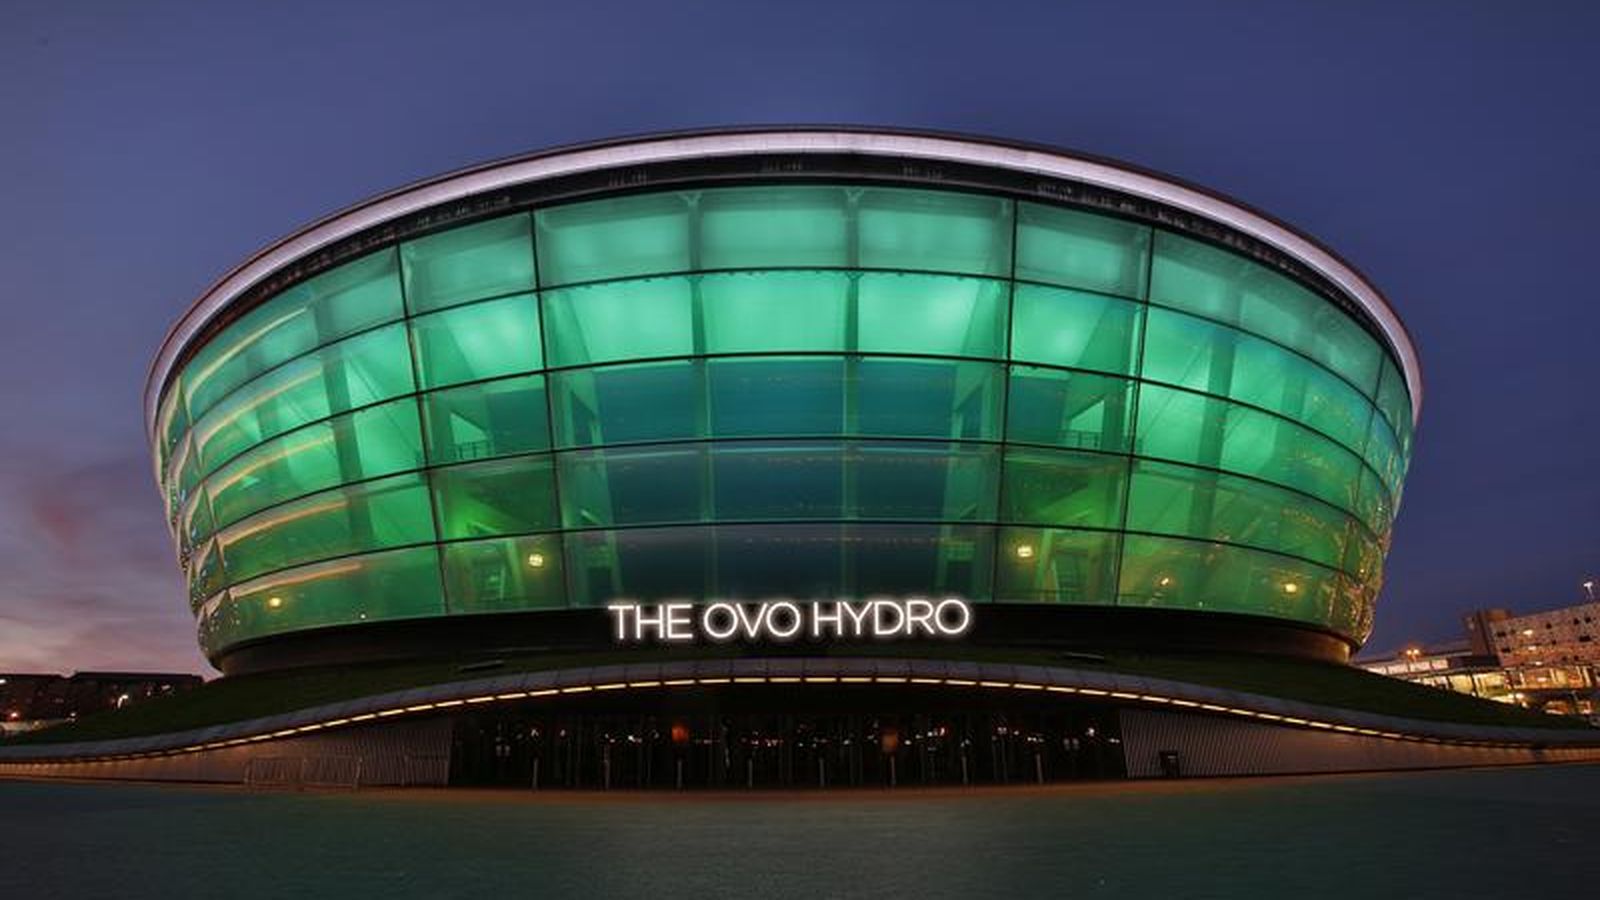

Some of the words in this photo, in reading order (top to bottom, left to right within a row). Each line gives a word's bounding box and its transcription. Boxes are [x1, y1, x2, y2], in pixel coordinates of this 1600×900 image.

[607, 603, 693, 639] THE
[703, 601, 801, 639] OVO
[813, 598, 970, 636] HYDRO
